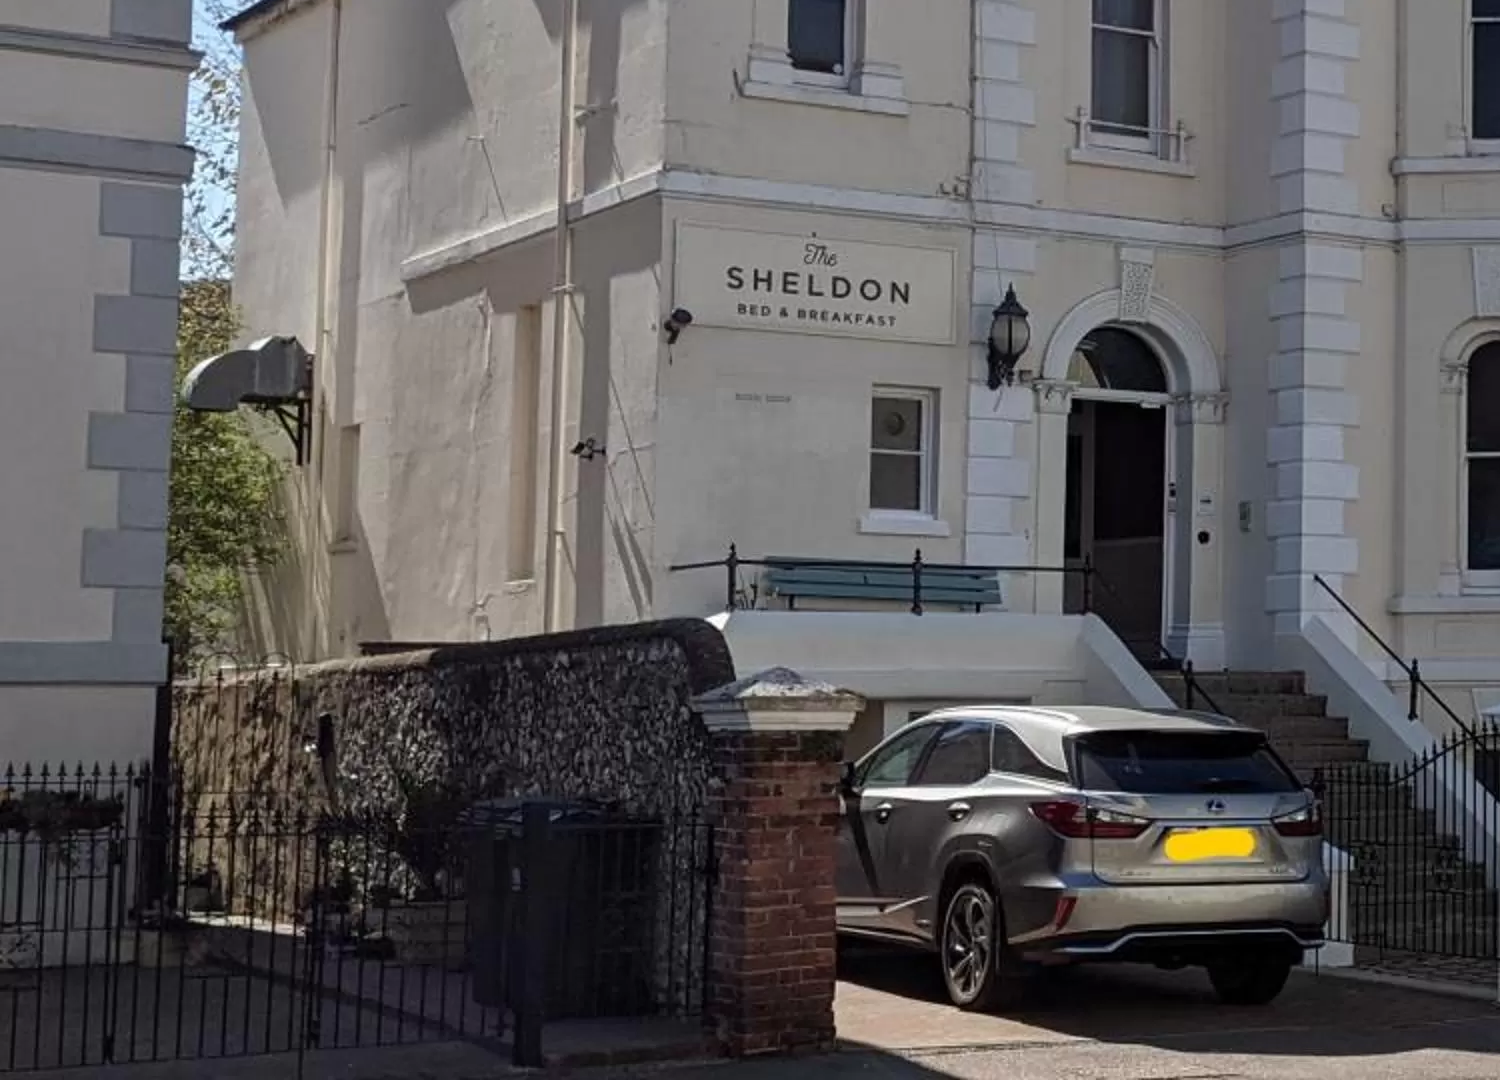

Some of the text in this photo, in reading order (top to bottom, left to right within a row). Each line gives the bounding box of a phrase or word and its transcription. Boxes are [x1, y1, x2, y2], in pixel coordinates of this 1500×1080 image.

[803, 243, 838, 266] The
[726, 267, 911, 305] SHELDON
[737, 303, 897, 327] BED & BREAKFAST
